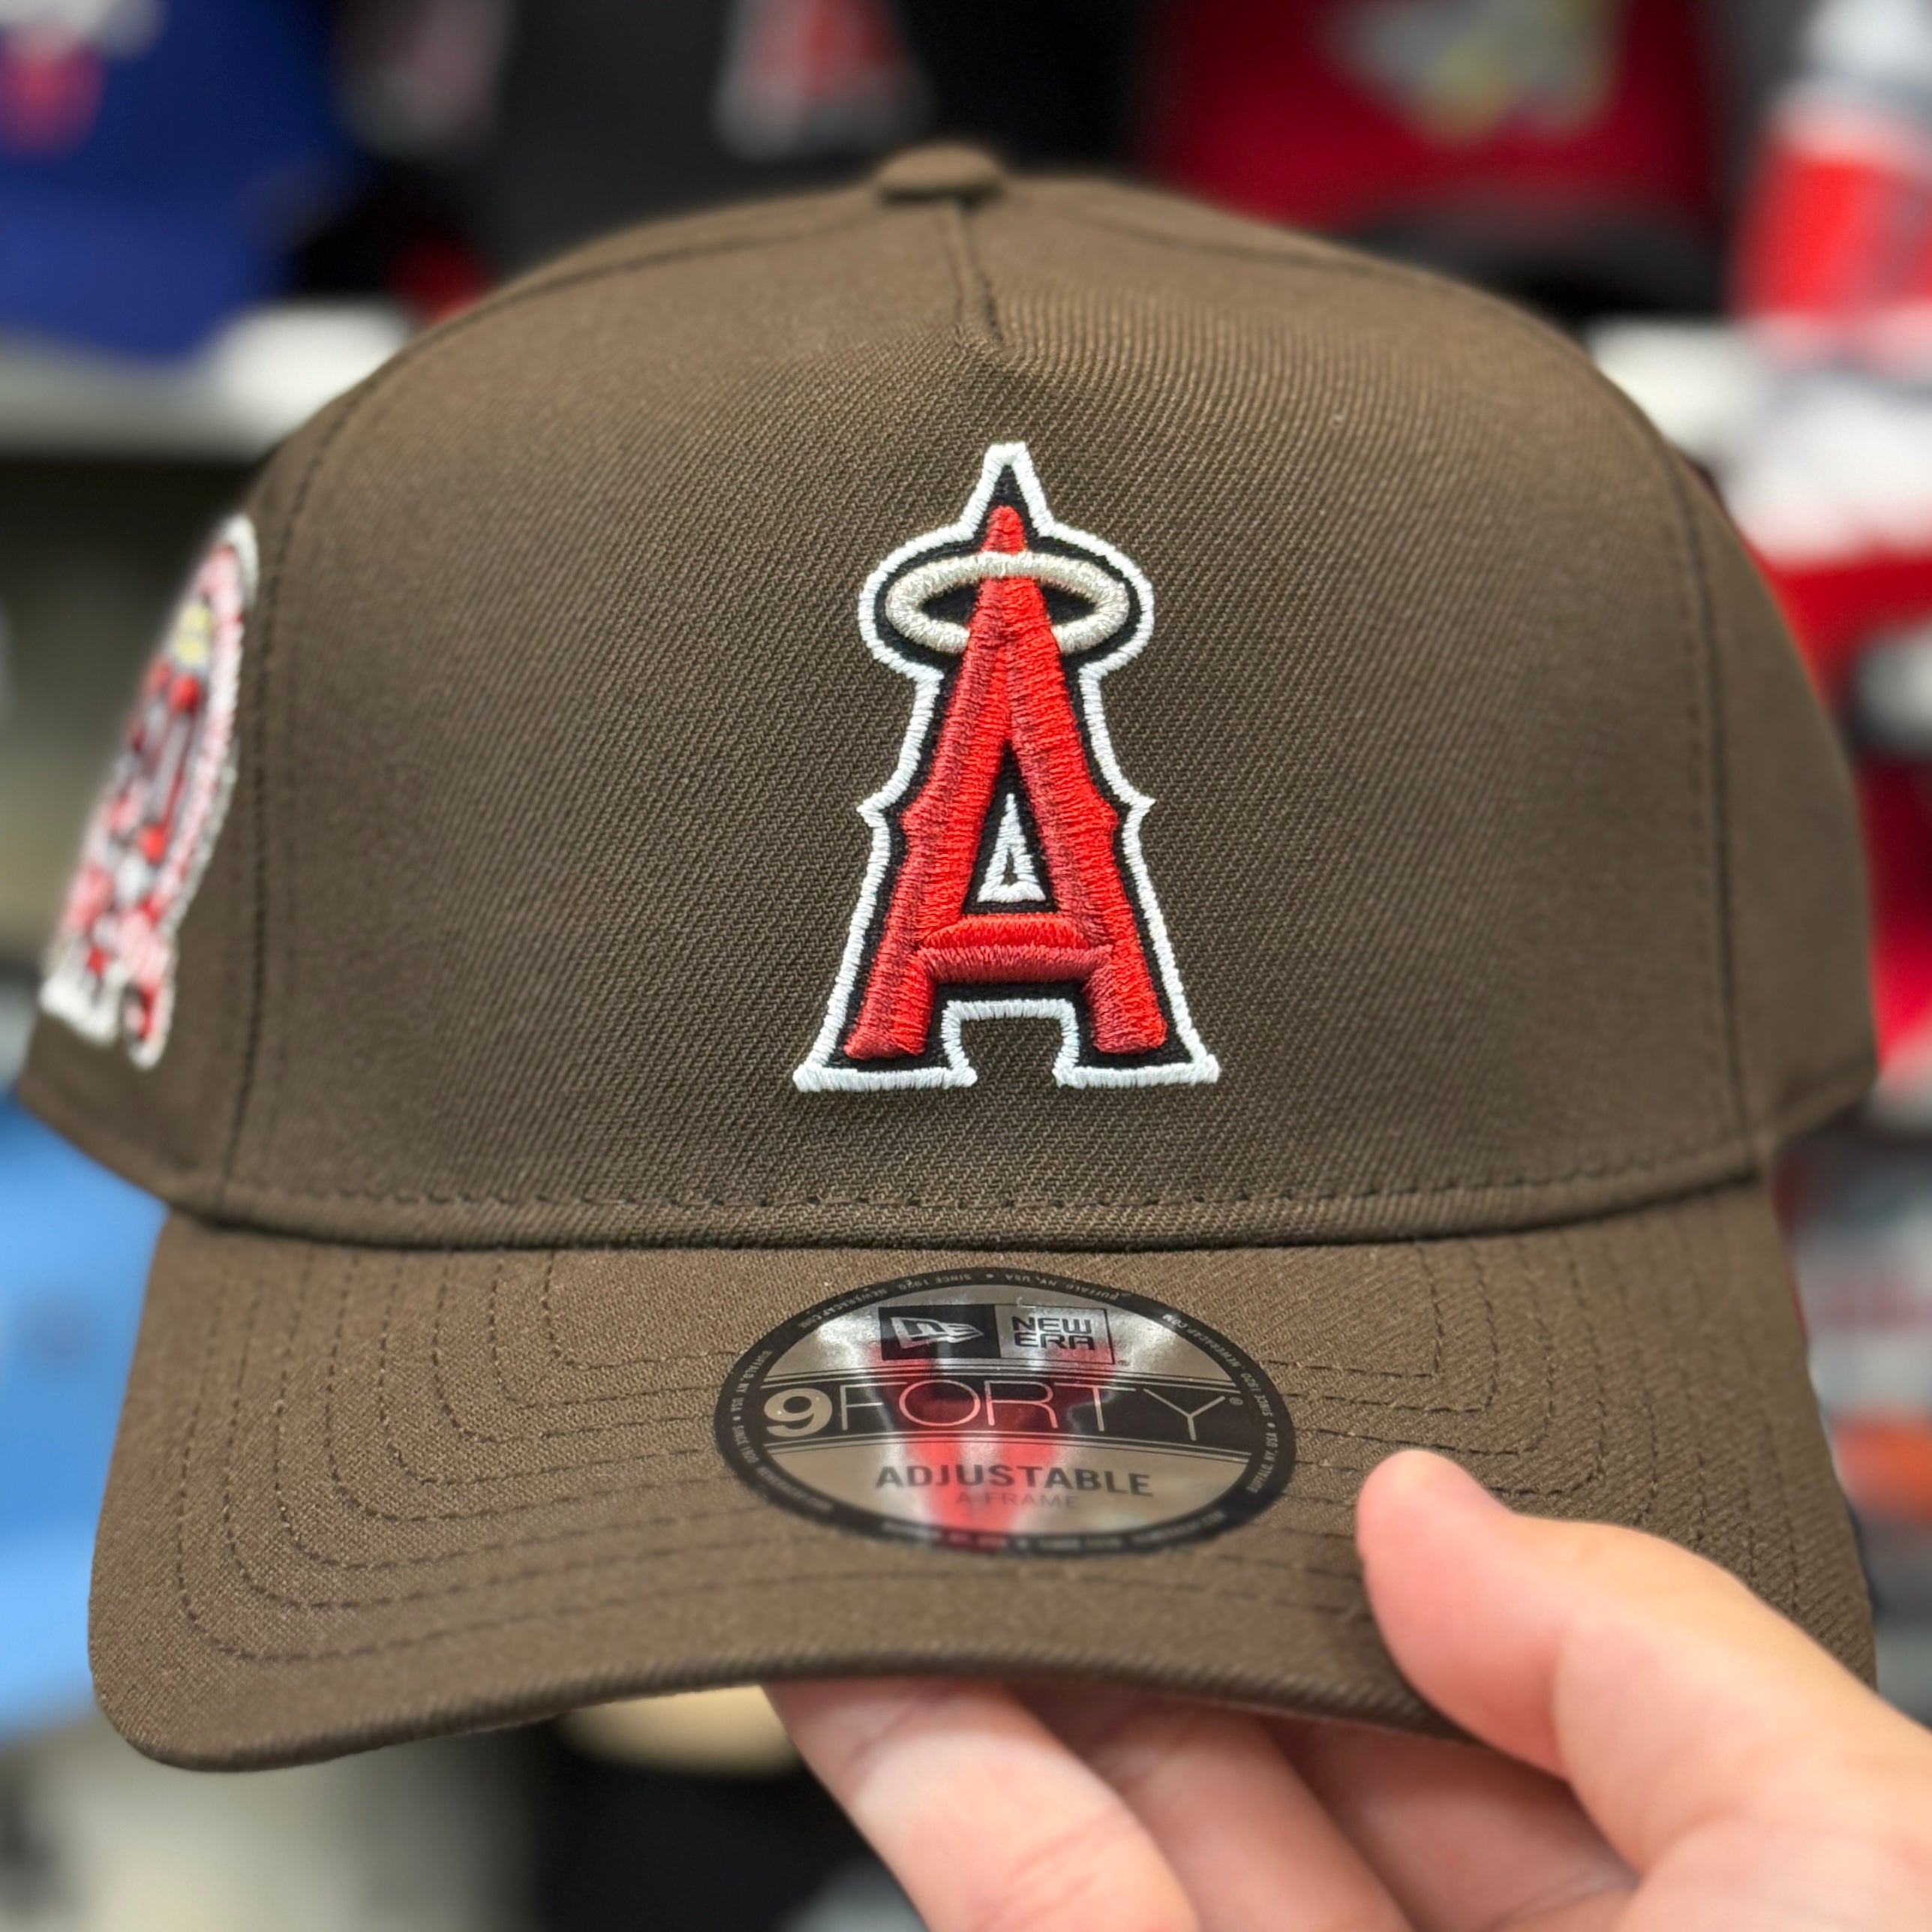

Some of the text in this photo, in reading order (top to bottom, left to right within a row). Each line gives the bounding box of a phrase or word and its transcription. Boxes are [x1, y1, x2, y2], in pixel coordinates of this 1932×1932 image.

[825, 480, 1194, 1074] A
[935, 1274, 972, 1284] SINCE
[1011, 1316, 1092, 1335] NEW
[1014, 1332, 1095, 1351] ERA
[763, 1380, 1225, 1441] 9FORTY
[1240, 1372, 1273, 1417] SINCE 1920
[874, 1464, 1154, 1498] ADJUSTABLE
